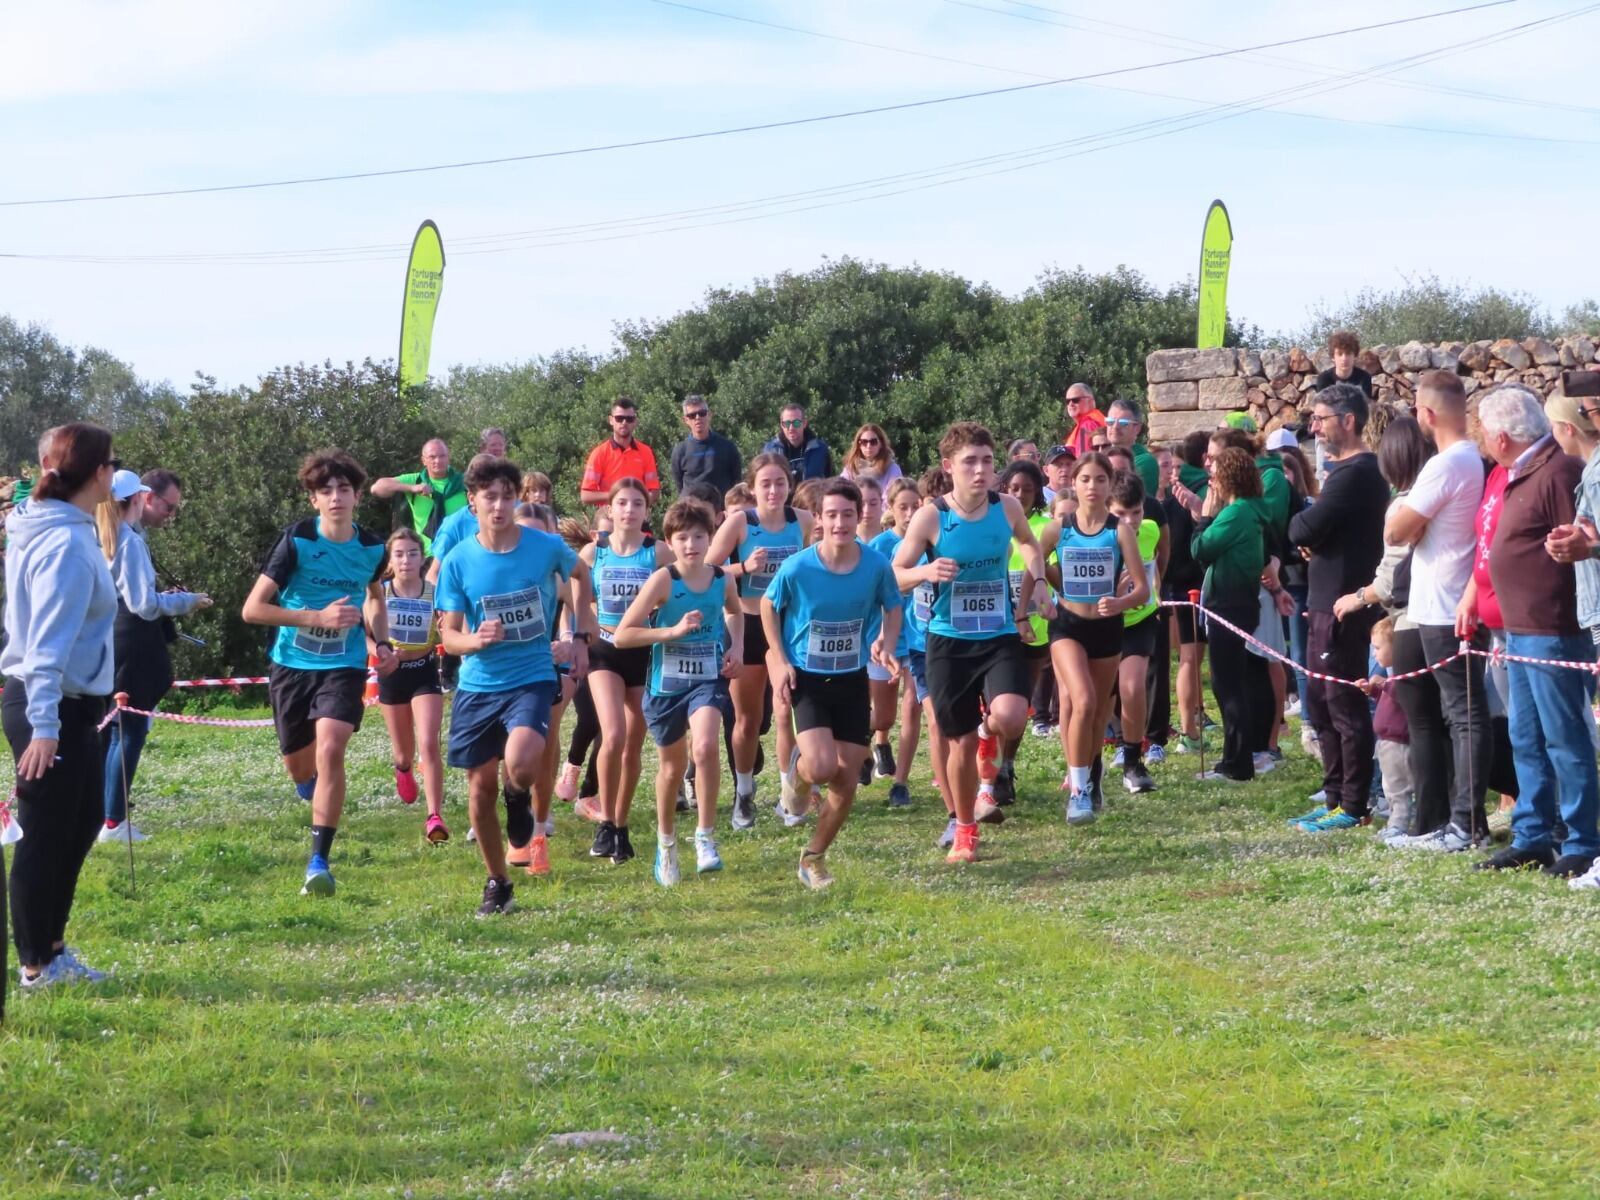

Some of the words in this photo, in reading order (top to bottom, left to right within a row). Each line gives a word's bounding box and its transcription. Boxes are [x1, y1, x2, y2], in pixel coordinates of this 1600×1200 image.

[1073, 565, 1105, 578] 1069
[311, 576, 360, 589] cecome
[963, 598, 995, 612] 1065
[396, 613, 422, 627] 1169
[498, 607, 533, 625] 1064
[819, 638, 852, 653] 1082
[401, 658, 425, 669] PRO
[678, 660, 703, 675] 1111
